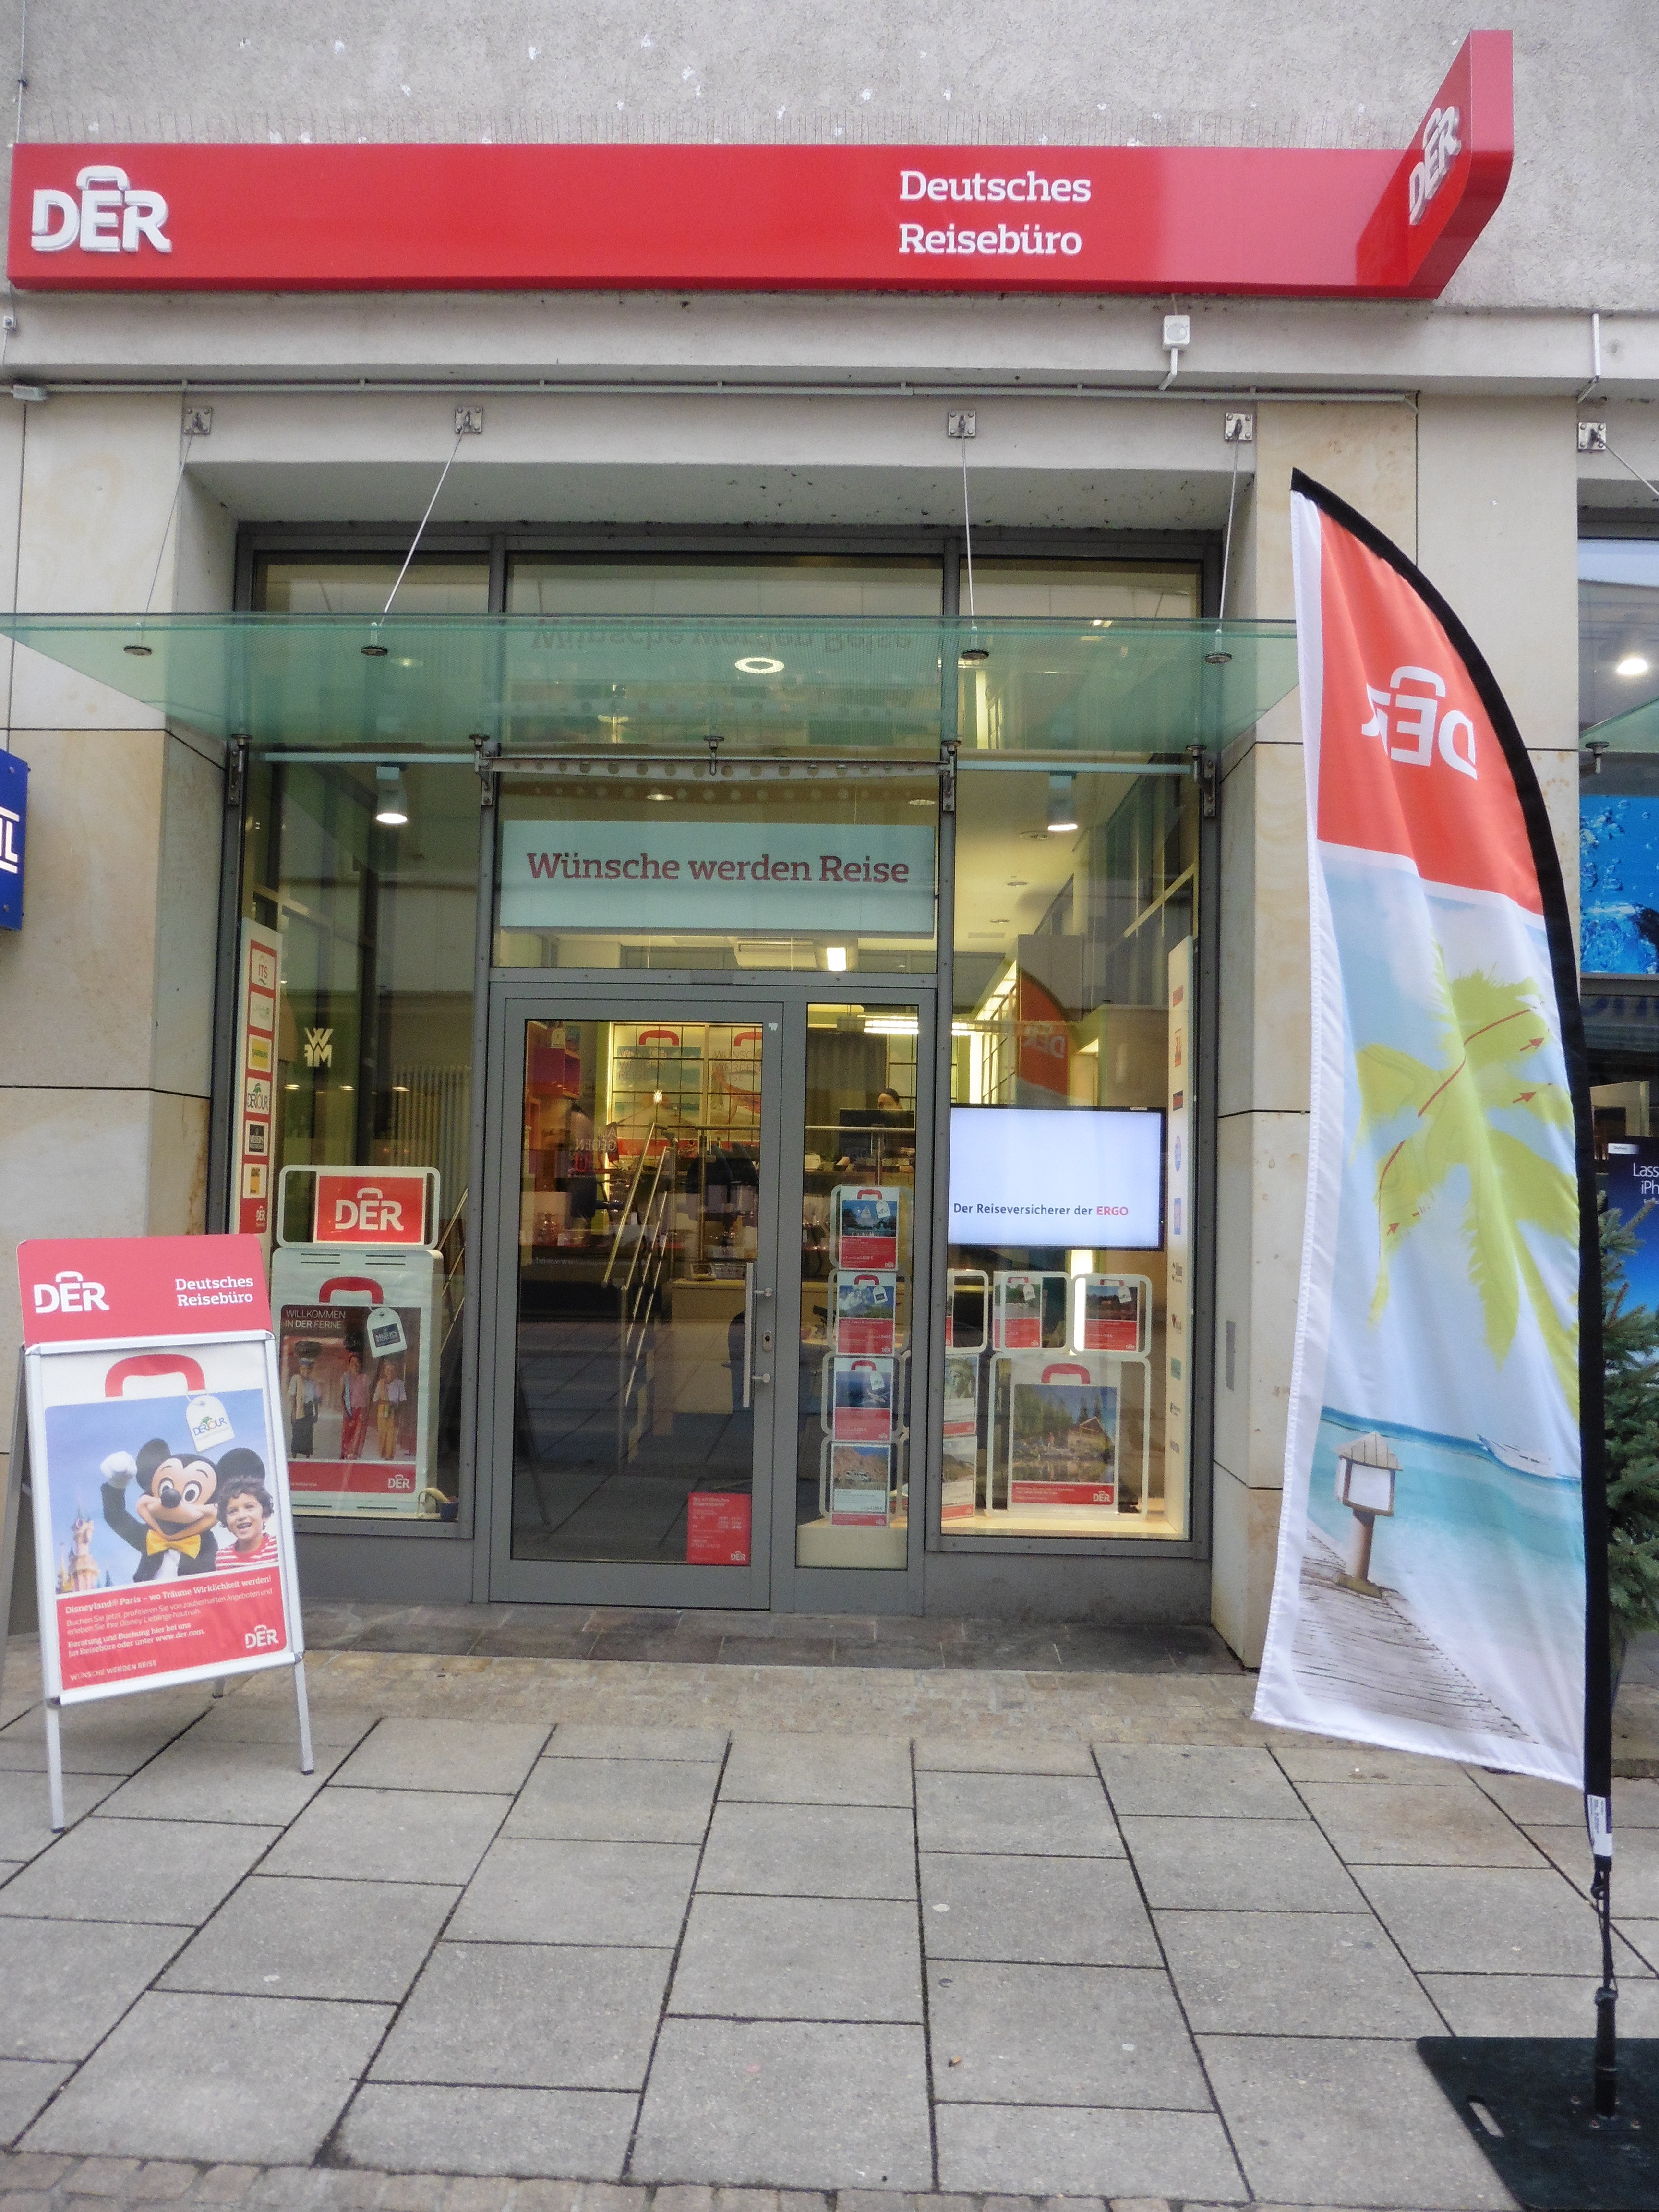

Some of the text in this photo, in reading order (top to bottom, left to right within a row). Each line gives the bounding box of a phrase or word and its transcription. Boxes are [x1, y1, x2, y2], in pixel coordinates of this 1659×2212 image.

[1409, 106, 1461, 225] DER
[899, 170, 1091, 202] Deutsches
[31, 185, 172, 253] DER
[898, 223, 1082, 255] Reisebüro
[527, 853, 909, 884] Wünsche werden Reise
[1633, 1162, 1659, 1177] Lass
[335, 1199, 404, 1231] DER
[953, 1203, 1129, 1216] Der Reiseversicherer der ERGO
[175, 1276, 253, 1291] Deutsches
[34, 1280, 109, 1313] DER
[177, 1291, 253, 1307] Reisebüro
[286, 1310, 346, 1319] WILLKOMMEN
[285, 1320, 342, 1329] IN DER FERNE
[388, 1476, 410, 1489] DER
[1093, 1493, 1111, 1502] DER
[120, 1597, 141, 1605] Paris
[162, 1588, 192, 1599] Träume
[193, 1581, 240, 1594] Wirklichkeit
[241, 1575, 271, 1587] werden!
[183, 1596, 226, 1608] zauberhaften
[68, 1637, 103, 1648] Beratung
[103, 1633, 117, 1642] und
[118, 1629, 150, 1640] Buchung
[151, 1626, 164, 1635] hier
[117, 1638, 133, 1648] oder
[135, 1636, 154, 1646] unter
[245, 1626, 279, 1649] DER
